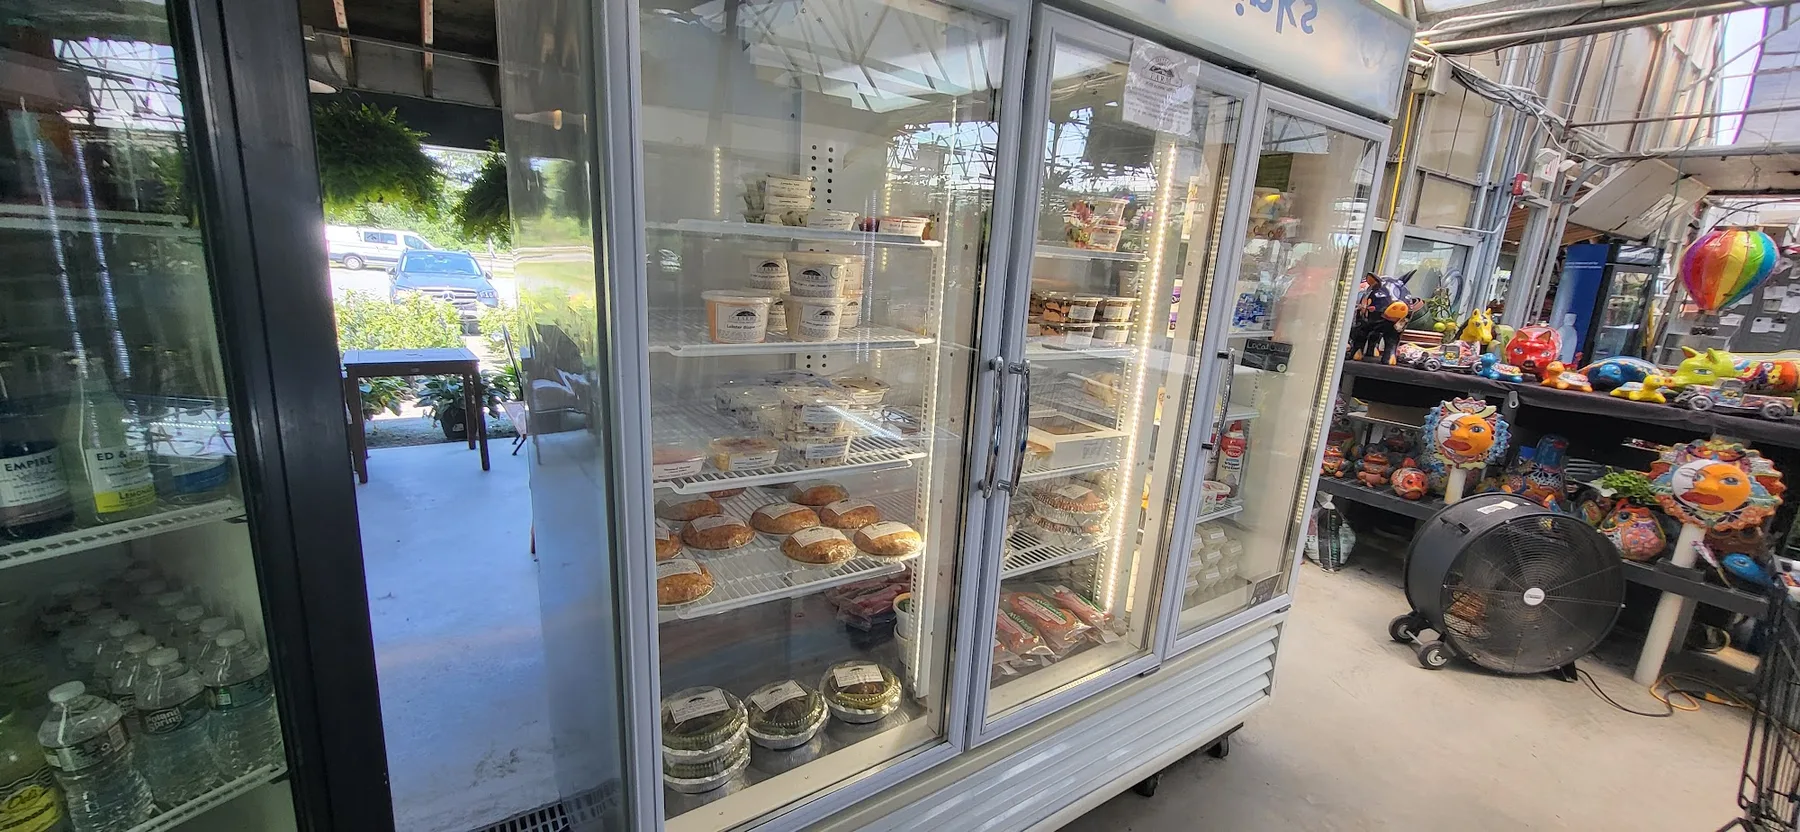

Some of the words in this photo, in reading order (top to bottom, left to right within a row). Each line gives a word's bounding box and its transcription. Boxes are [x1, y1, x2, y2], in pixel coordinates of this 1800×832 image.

[4, 455, 53, 472] EMPIRE
[145, 706, 181, 724] Poland
[148, 714, 183, 733] Spring
